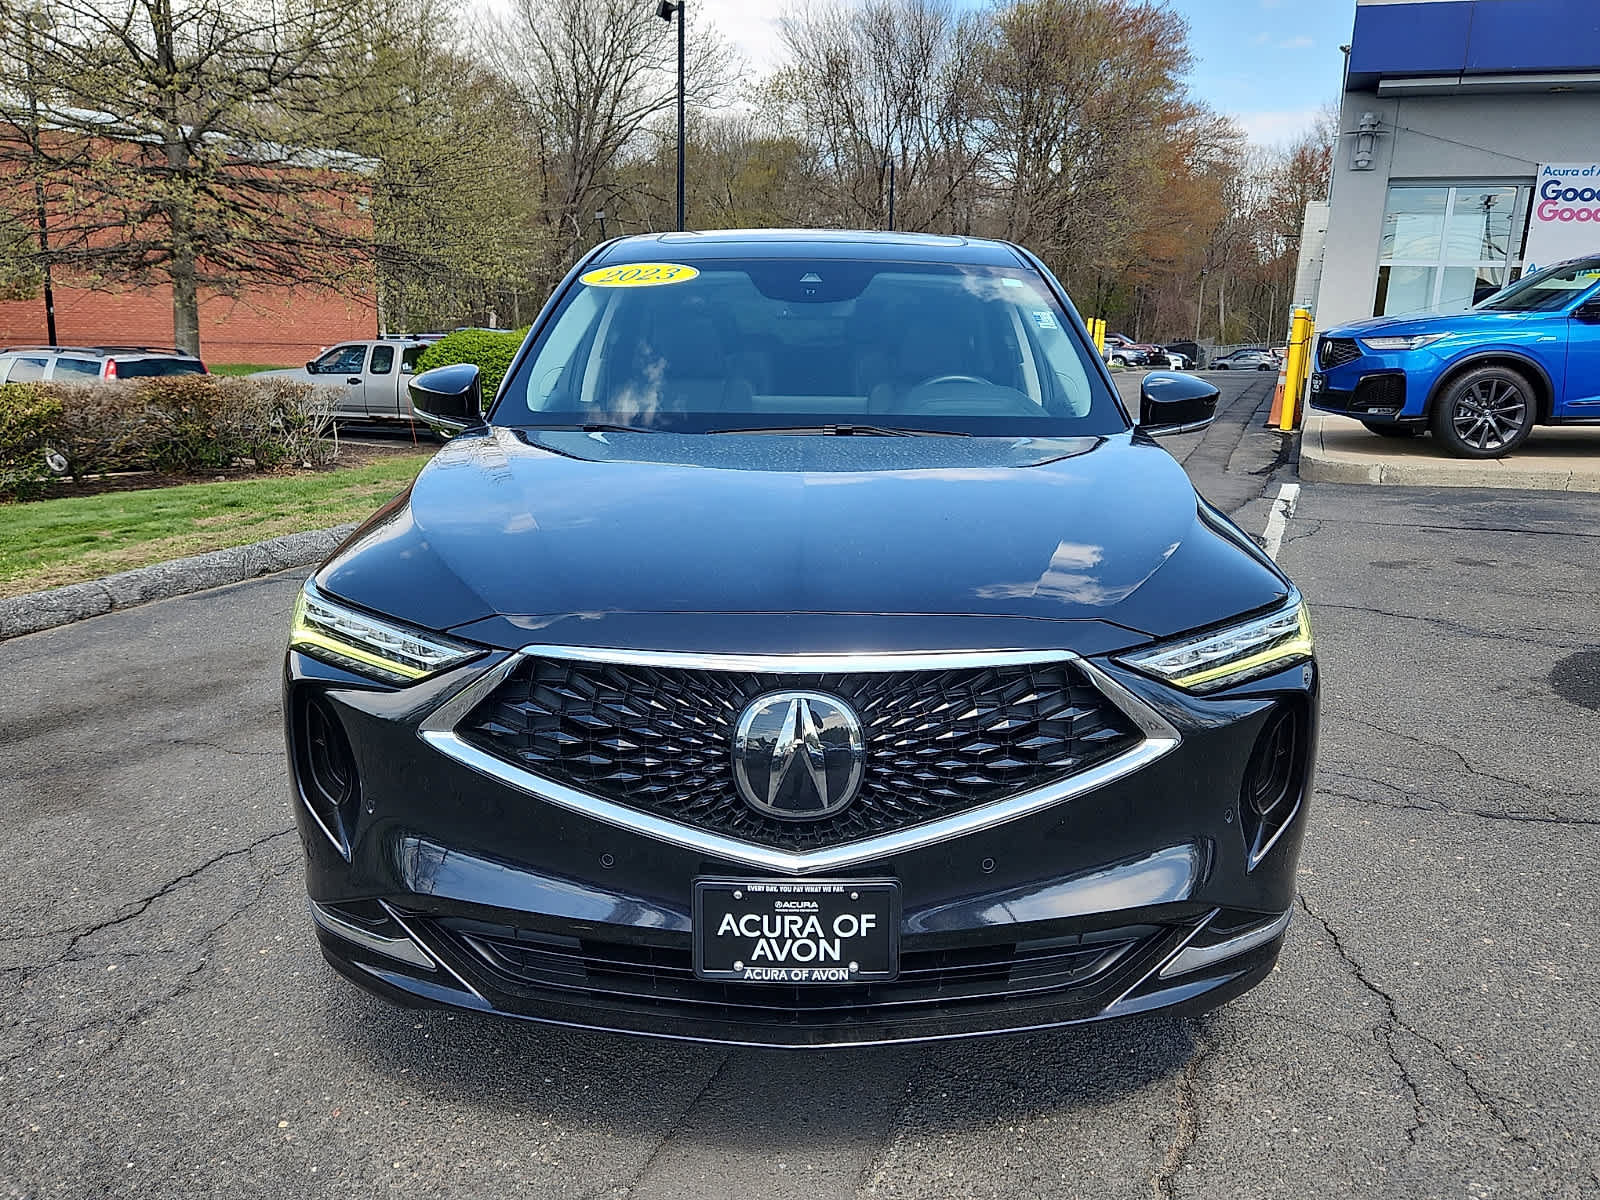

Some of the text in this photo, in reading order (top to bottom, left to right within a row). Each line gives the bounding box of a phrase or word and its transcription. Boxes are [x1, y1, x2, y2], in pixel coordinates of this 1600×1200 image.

[1543, 166, 1579, 176] Acura
[1582, 165, 1596, 176] of
[1541, 180, 1600, 201] Goo
[598, 268, 681, 282] 2023
[717, 913, 876, 938] ACURA OF
[751, 938, 840, 961] AVON
[743, 969, 849, 981] ACURA OF AVON
